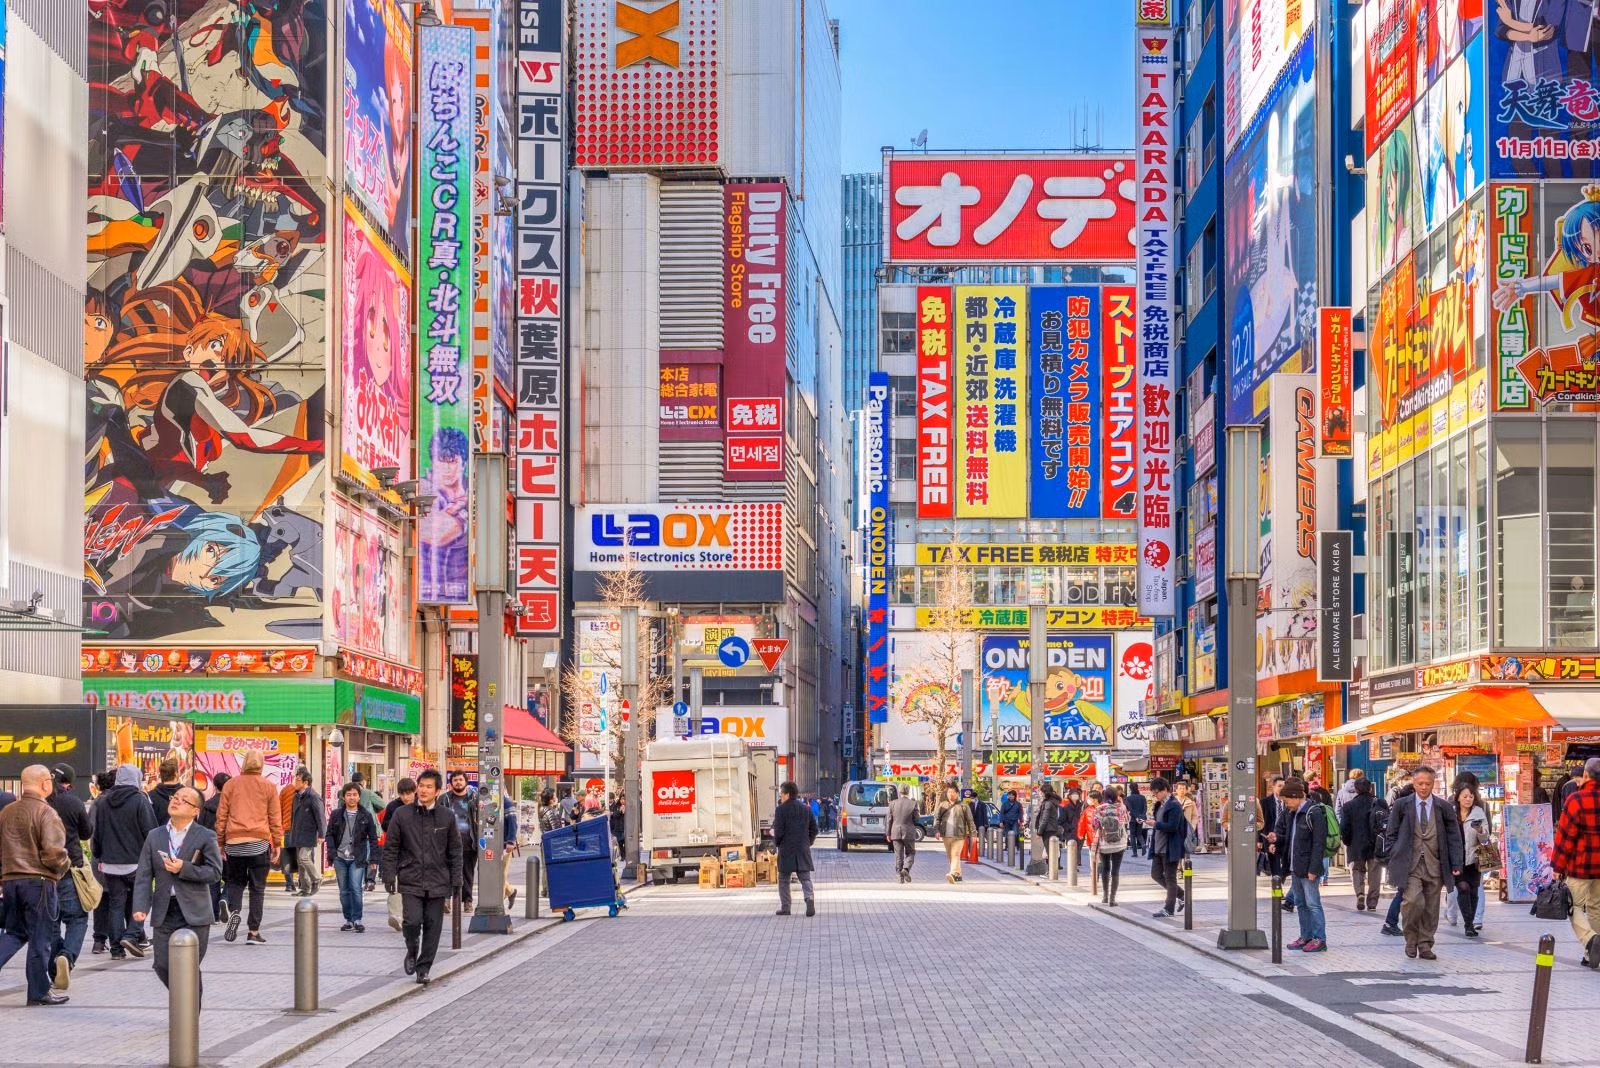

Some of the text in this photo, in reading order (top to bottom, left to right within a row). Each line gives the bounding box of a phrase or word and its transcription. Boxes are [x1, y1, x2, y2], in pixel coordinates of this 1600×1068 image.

[1142, 73, 1168, 222] TAKARADA
[728, 191, 745, 308] Flagship Store
[745, 191, 782, 344] Duty Free
[1143, 229, 1168, 300] TAX-FREE
[921, 296, 947, 356] 免税
[1143, 305, 1169, 377] 免税商店
[660, 367, 689, 381] 本店
[1330, 324, 1342, 404] カードキングダム
[660, 383, 717, 397] 総合家電
[1040, 310, 1063, 480] お見積り無料です
[660, 406, 717, 419] LaOX
[732, 404, 777, 425] 免税
[870, 385, 887, 493] Panasonic
[922, 361, 948, 504] TAX FREE
[730, 446, 778, 462] 면세점
[1143, 383, 1170, 529] 歓迎光臨
[1296, 387, 1317, 565] GAMERS
[590, 552, 733, 562] Home Electronics Store
[871, 506, 886, 594] ONODEN
[927, 546, 1034, 563] TAX FREE
[1039, 546, 1089, 563] 免税店
[1332, 542, 1340, 670] ALIENWARE STORE AKIBA
[978, 609, 1028, 625] 冷蔵庫
[1046, 610, 1096, 625] アコン
[760, 645, 781, 653] 止まれ
[1063, 640, 1074, 648] to
[985, 648, 1105, 669] ONDEN
[1561, 657, 1600, 679] カー
[1049, 751, 1091, 764] オノデン
[890, 764, 939, 775] カーペット
[1003, 764, 1089, 776] オデン
